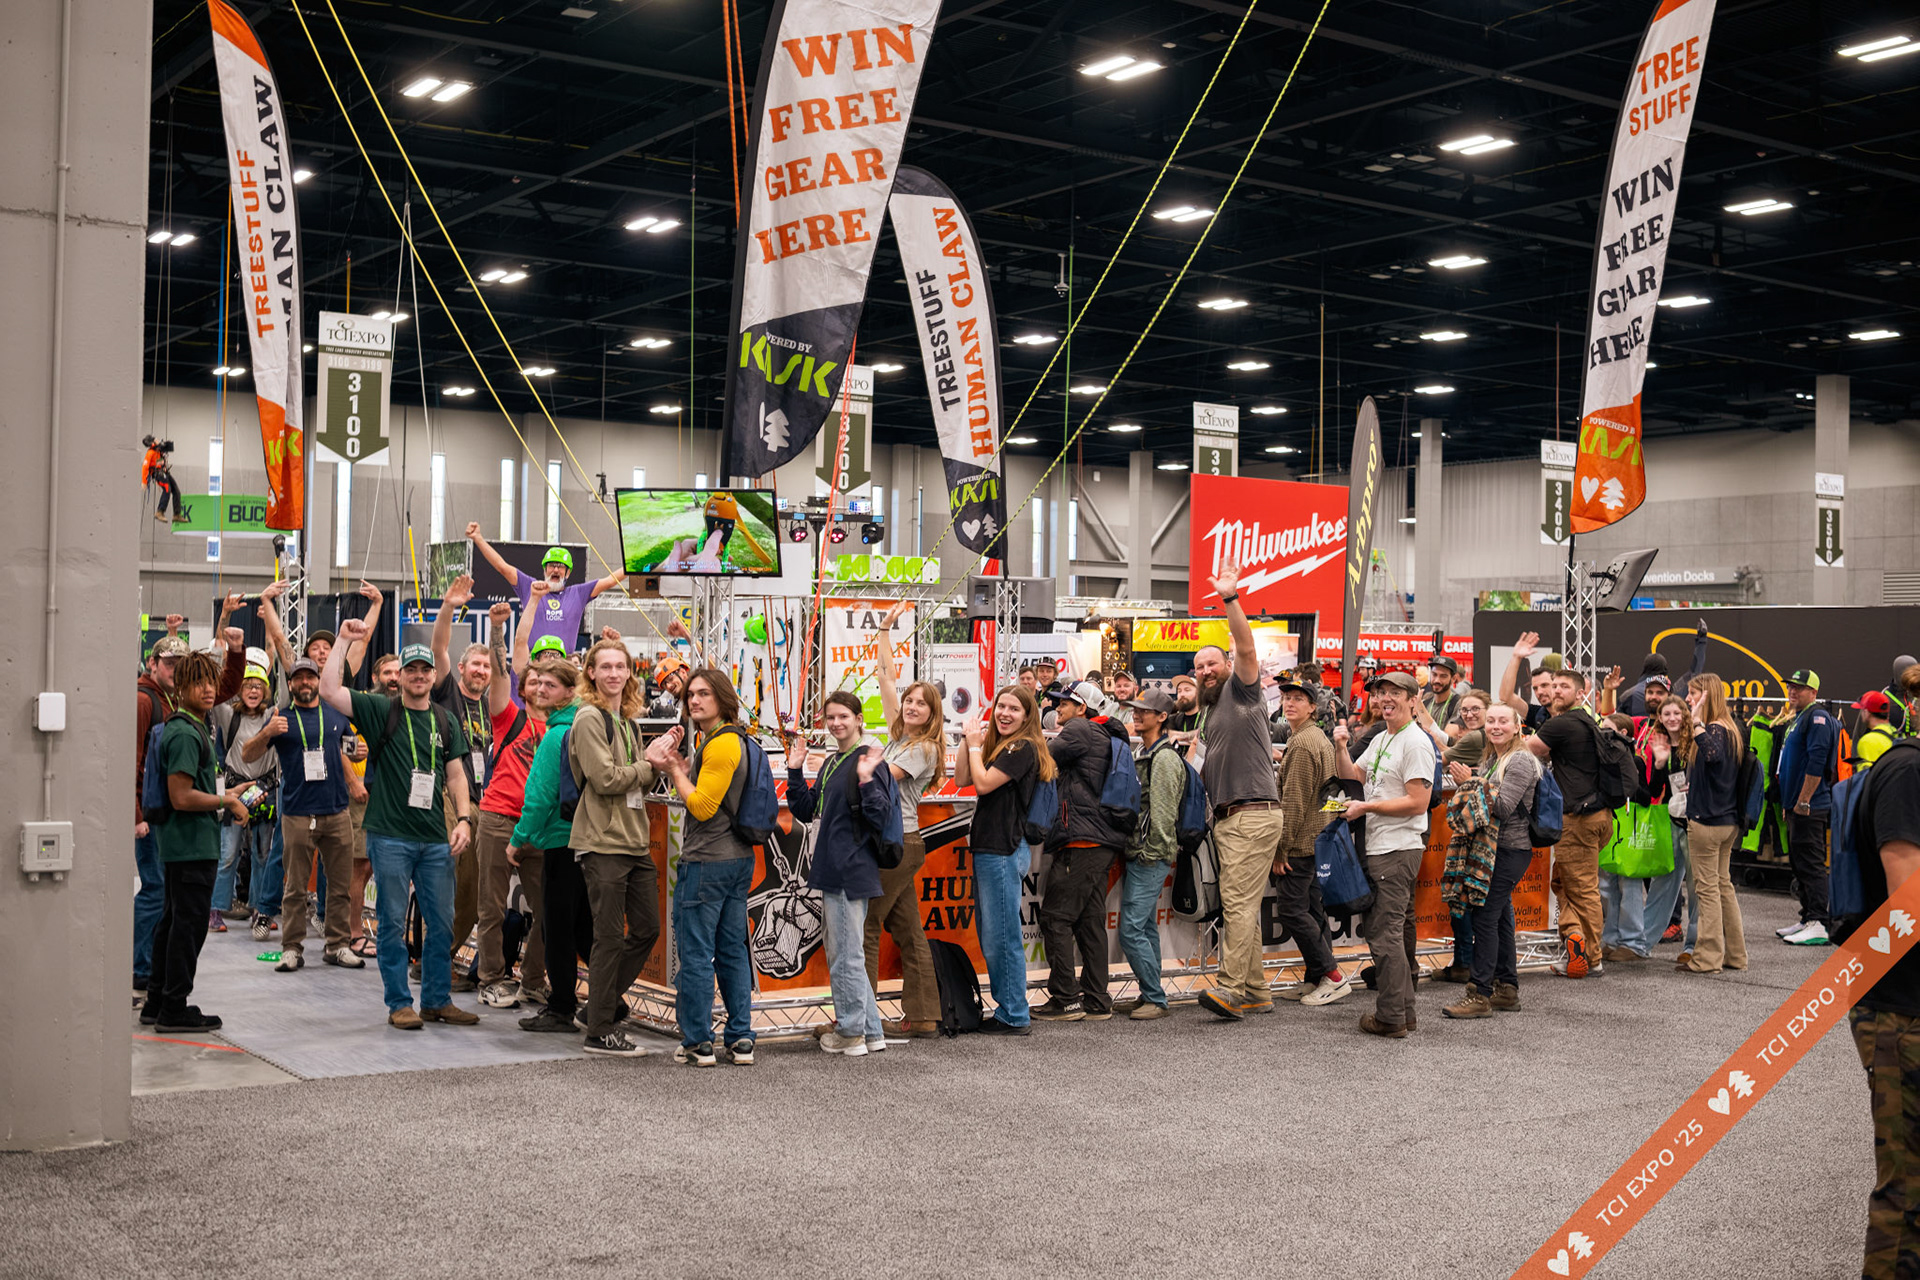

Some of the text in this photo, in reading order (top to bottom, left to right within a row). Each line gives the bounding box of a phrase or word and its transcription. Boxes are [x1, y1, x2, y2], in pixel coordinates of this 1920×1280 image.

[782, 23, 915, 78] WIN
[1637, 35, 1700, 95] TREE
[769, 87, 901, 143] FREE
[1629, 82, 1691, 136] STUFF
[253, 74, 287, 214] CLAW
[765, 147, 888, 201] GEAR
[1612, 157, 1675, 218] WIN
[237, 149, 275, 338] TREESTUFF
[797, 341, 813, 354] BY
[915, 269, 960, 412] TREESTUFF
[933, 207, 994, 458] HUMAN CLAW
[346, 372, 361, 458] 3100
[1589, 416, 1629, 433] POWERED
[228, 504, 267, 523] BUC
[1554, 481, 1563, 541] 3400
[1202, 512, 1347, 578] Milwaukee
[1684, 570, 1716, 582] Docks
[846, 610, 854, 629] I
[1382, 640, 1408, 652] FOR
[1522, 884, 1542, 893] Limit
[1534, 873, 1542, 881] in
[1514, 905, 1542, 916] Wall of
[1516, 917, 1542, 927] Prizes!
[1064, 1002, 1080, 1012] HOKA
